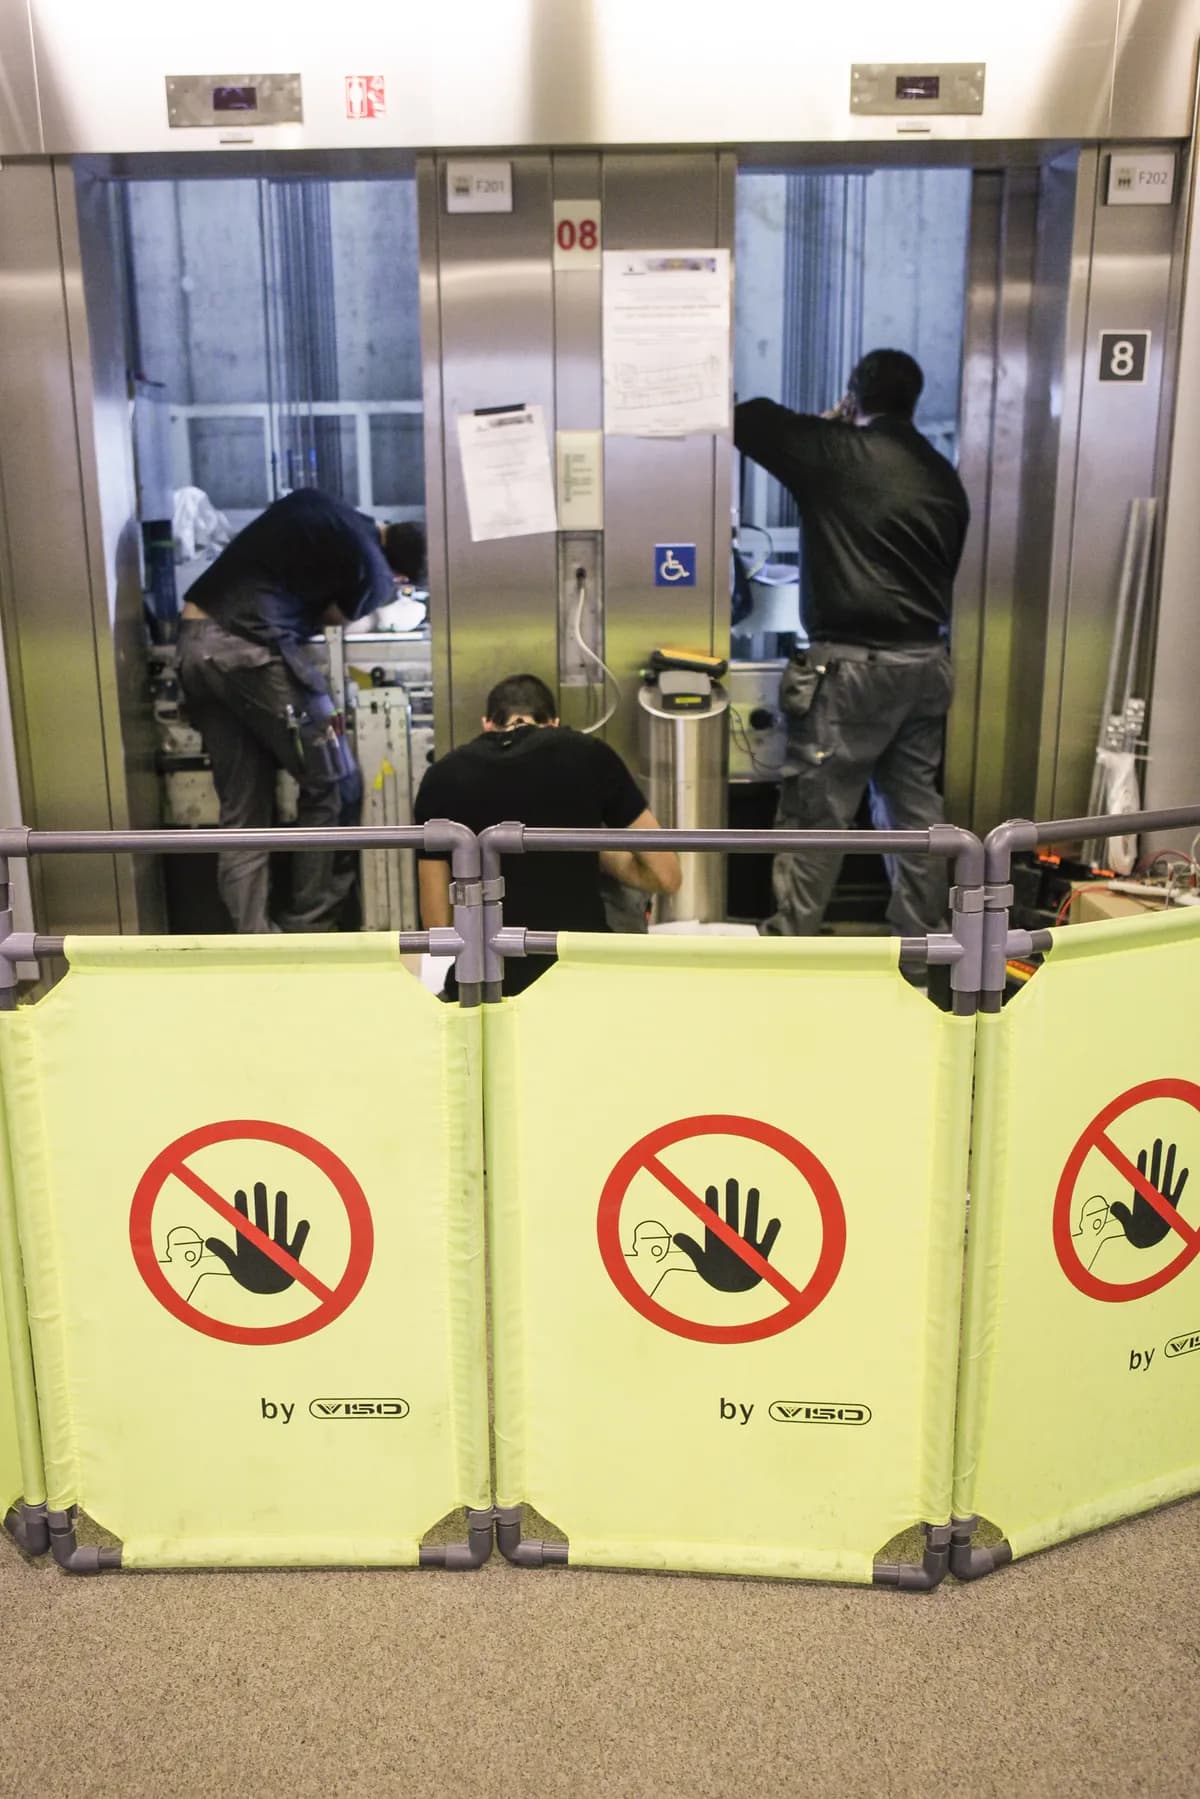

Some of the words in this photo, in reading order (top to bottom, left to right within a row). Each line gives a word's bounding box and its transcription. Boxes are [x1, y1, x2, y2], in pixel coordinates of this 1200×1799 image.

[476, 180, 505, 193] F201
[1138, 171, 1169, 185] F202
[557, 219, 598, 250] 08
[1110, 341, 1135, 376] 8
[1129, 1348, 1155, 1370] by
[261, 1397, 295, 1424] by
[317, 1403, 402, 1415] VISO
[720, 1397, 754, 1425] by
[776, 1406, 864, 1421] VISO
